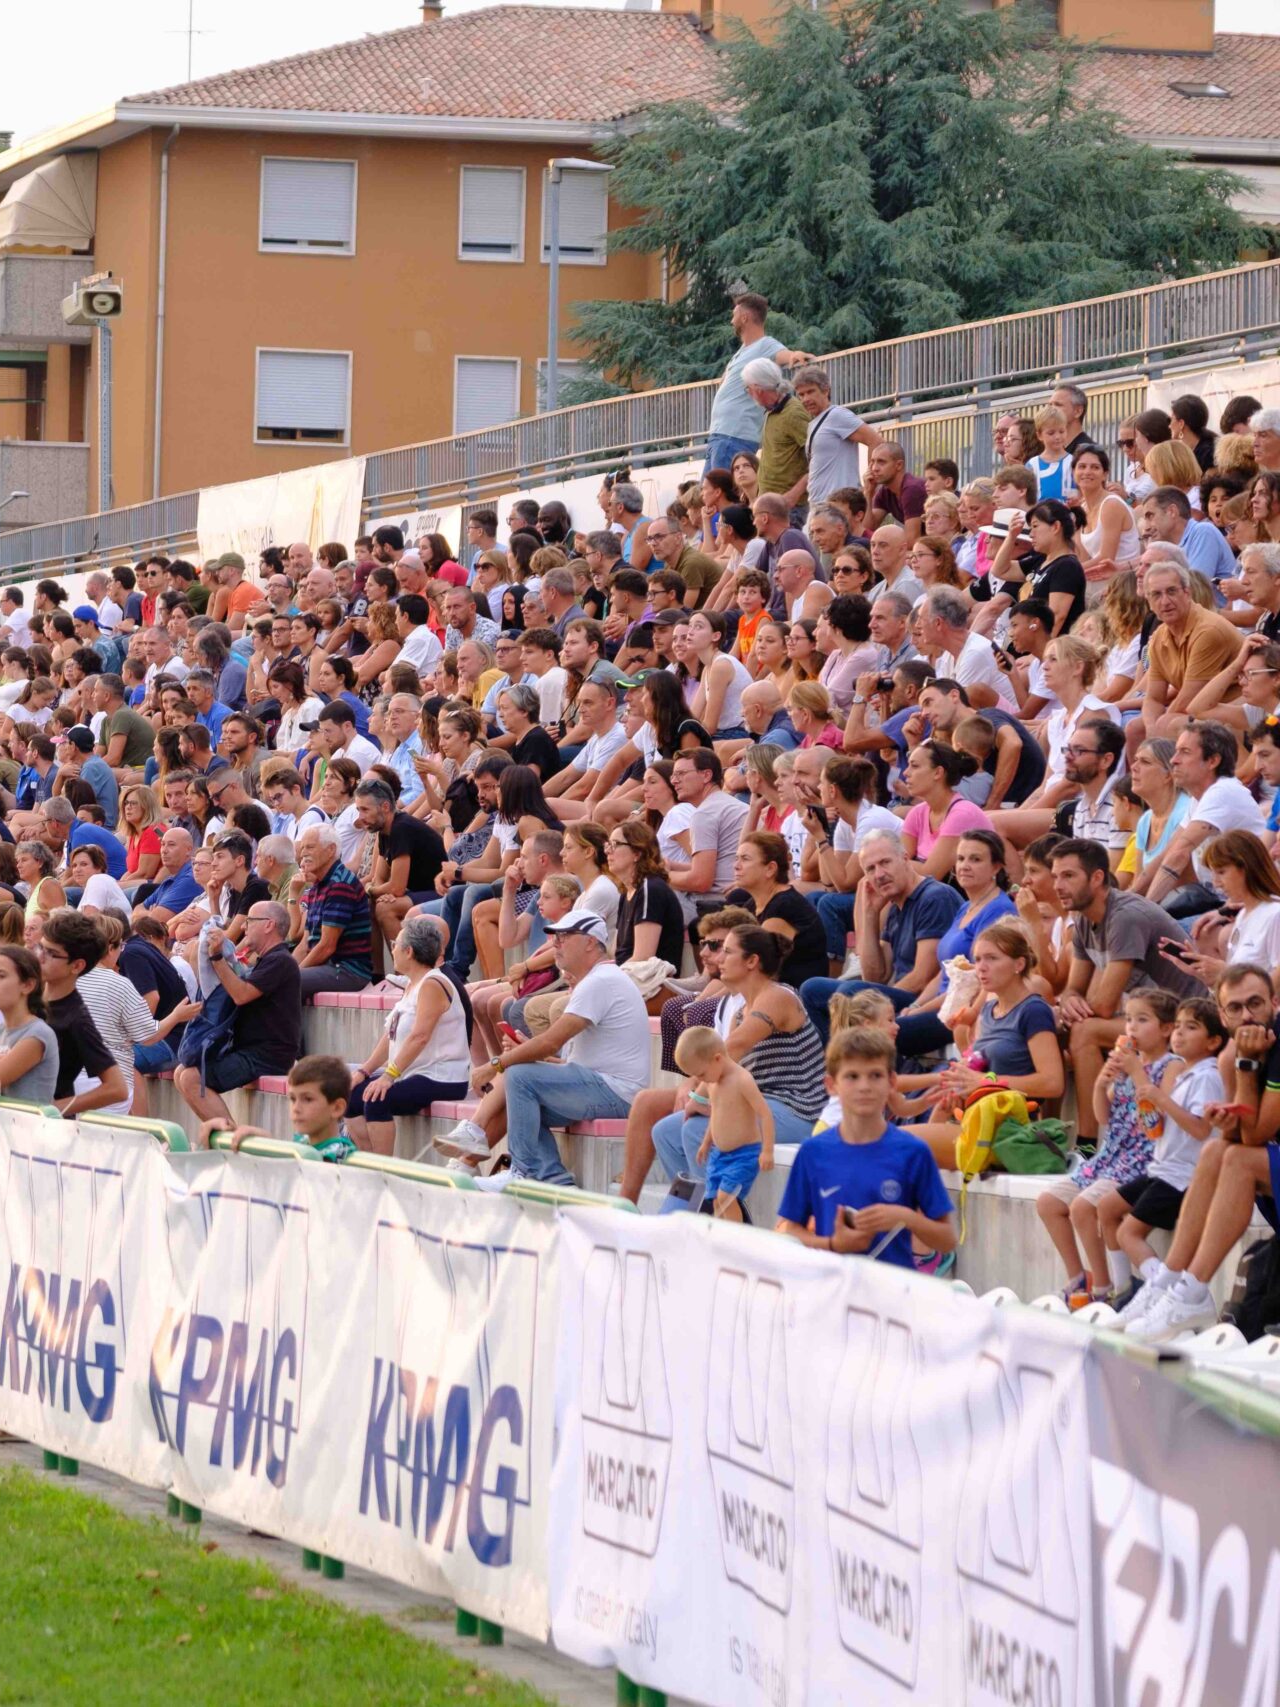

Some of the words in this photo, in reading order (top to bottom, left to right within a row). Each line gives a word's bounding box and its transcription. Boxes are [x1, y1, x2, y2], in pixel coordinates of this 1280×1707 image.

[149, 1306, 297, 1489] KPMG
[359, 1357, 524, 1568] KPMG
[587, 1451, 658, 1521] MARCATO
[722, 1489, 788, 1575] MARCATO
[837, 1548, 913, 1644] MARCATO
[969, 1615, 1062, 1707] MARCATO
